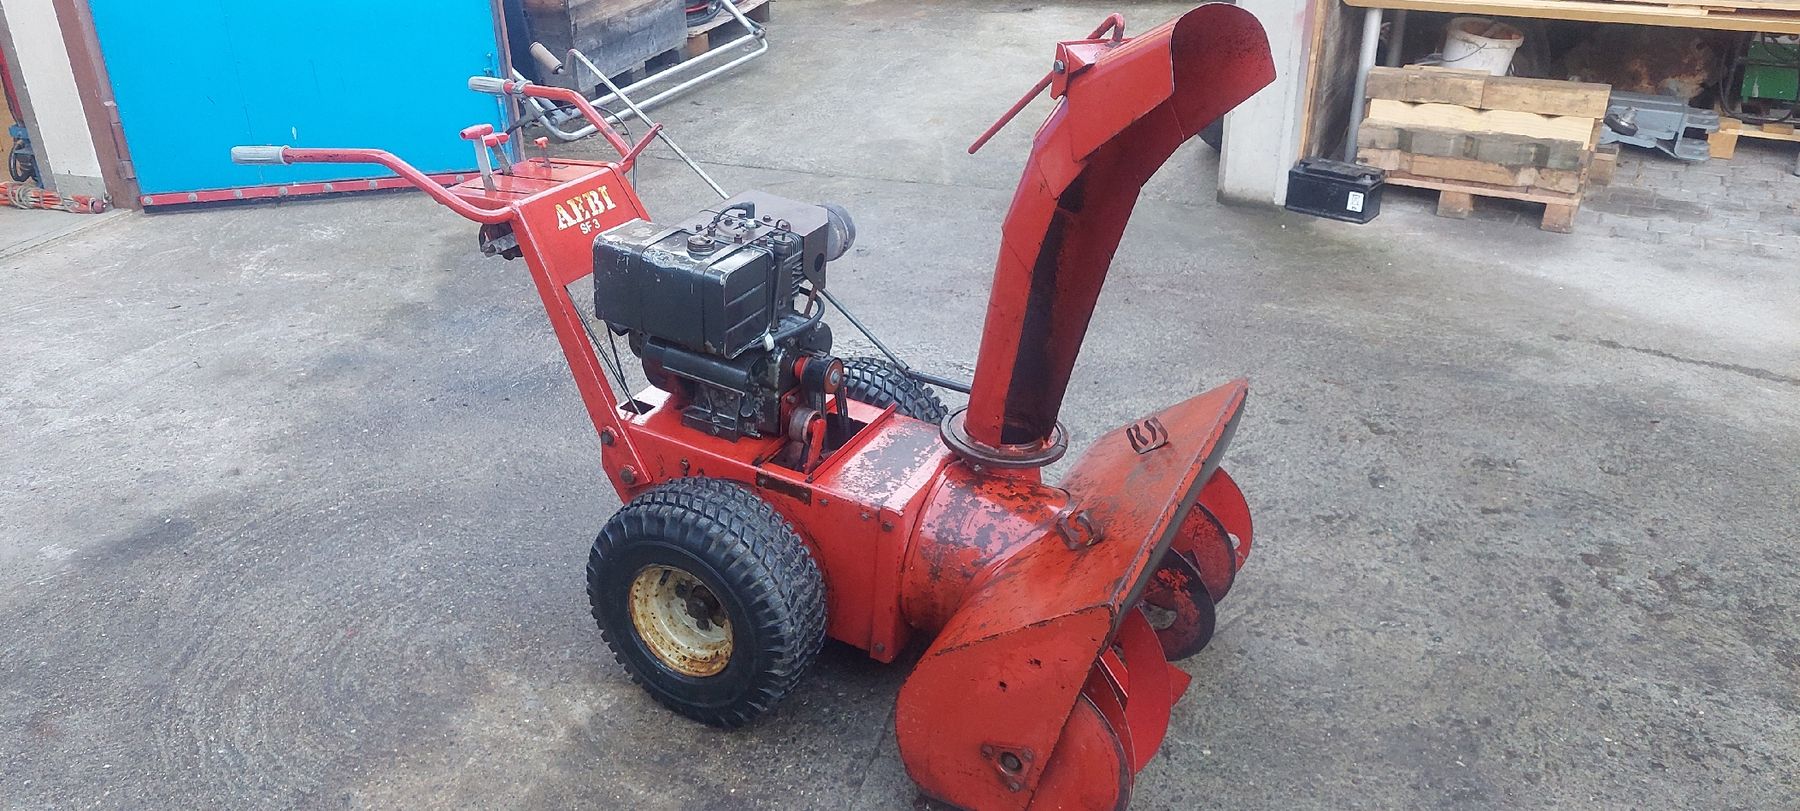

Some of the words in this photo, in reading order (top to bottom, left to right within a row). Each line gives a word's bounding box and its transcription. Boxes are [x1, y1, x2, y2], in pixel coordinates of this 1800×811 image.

[555, 184, 617, 231] AEBI
[579, 221, 593, 235] SF
[592, 218, 601, 229] 3
